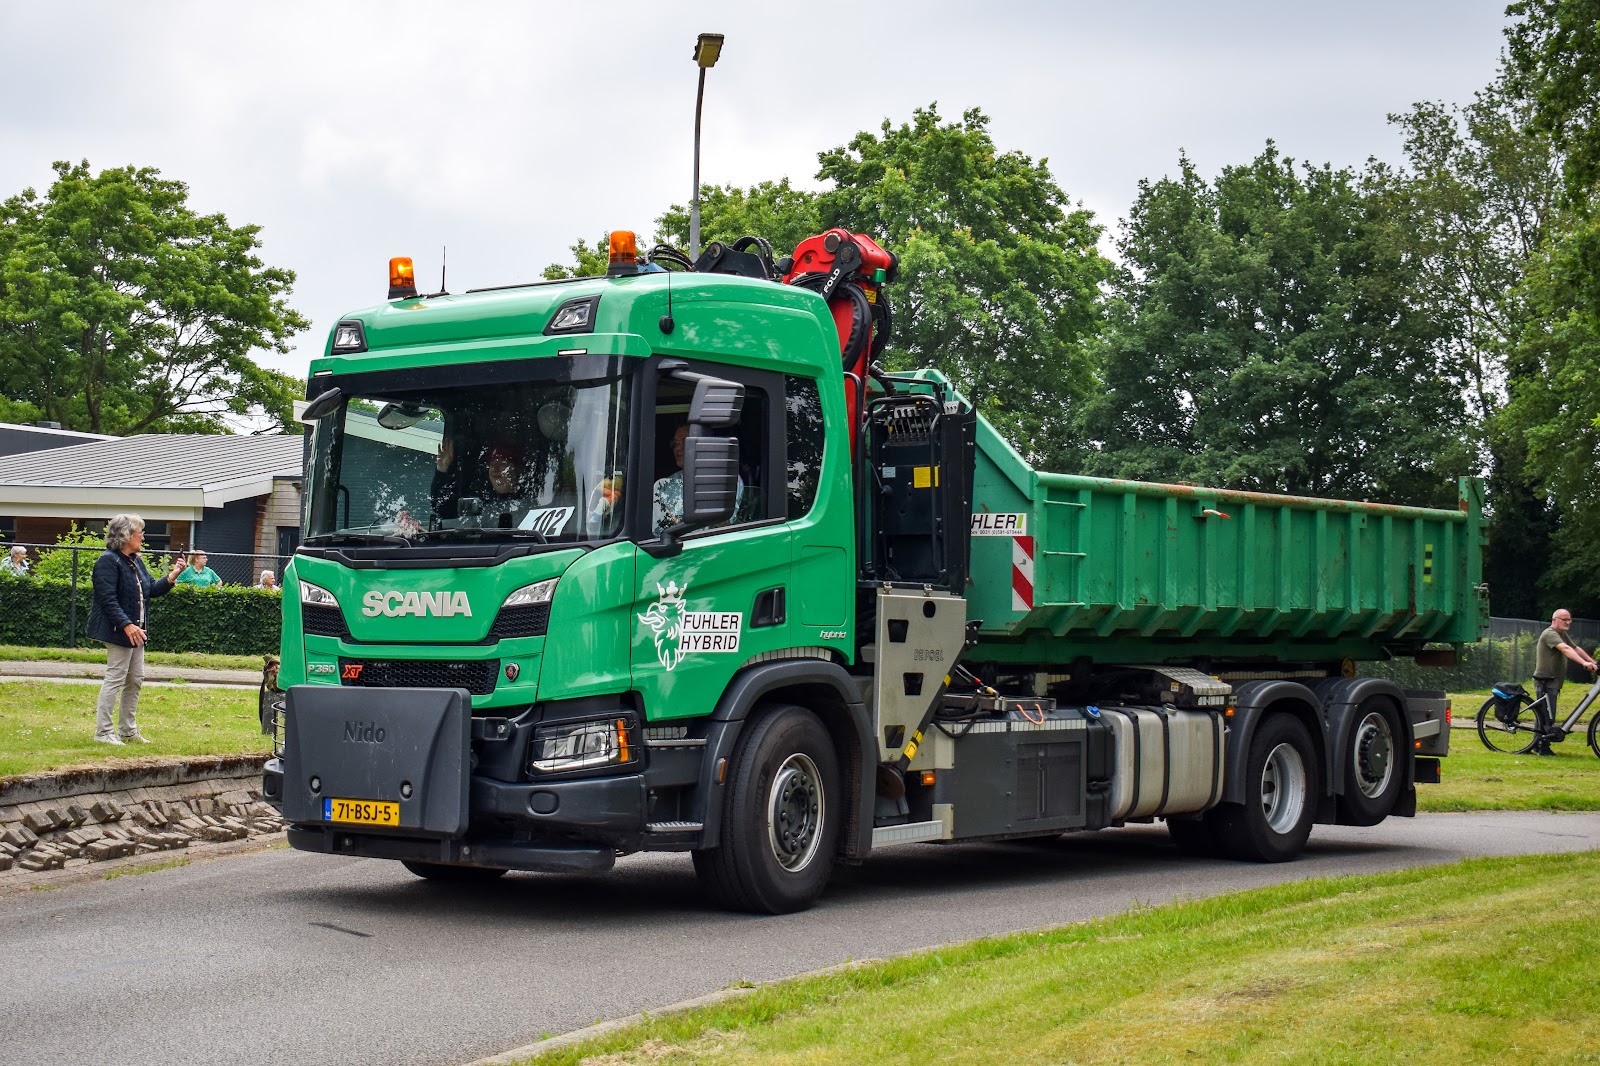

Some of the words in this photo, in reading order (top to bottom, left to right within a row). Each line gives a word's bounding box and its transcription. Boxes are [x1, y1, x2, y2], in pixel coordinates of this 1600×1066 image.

[823, 268, 840, 293] FOLD
[532, 508, 567, 535] 102
[362, 590, 473, 618] SCANIA
[683, 614, 739, 630] FUHLER
[680, 635, 738, 650] HYBRID
[819, 630, 847, 640] hybrid
[308, 664, 315, 673] P
[342, 664, 363, 679] XT
[343, 720, 387, 744] Nido
[337, 802, 392, 822] 71-BSJ-5
